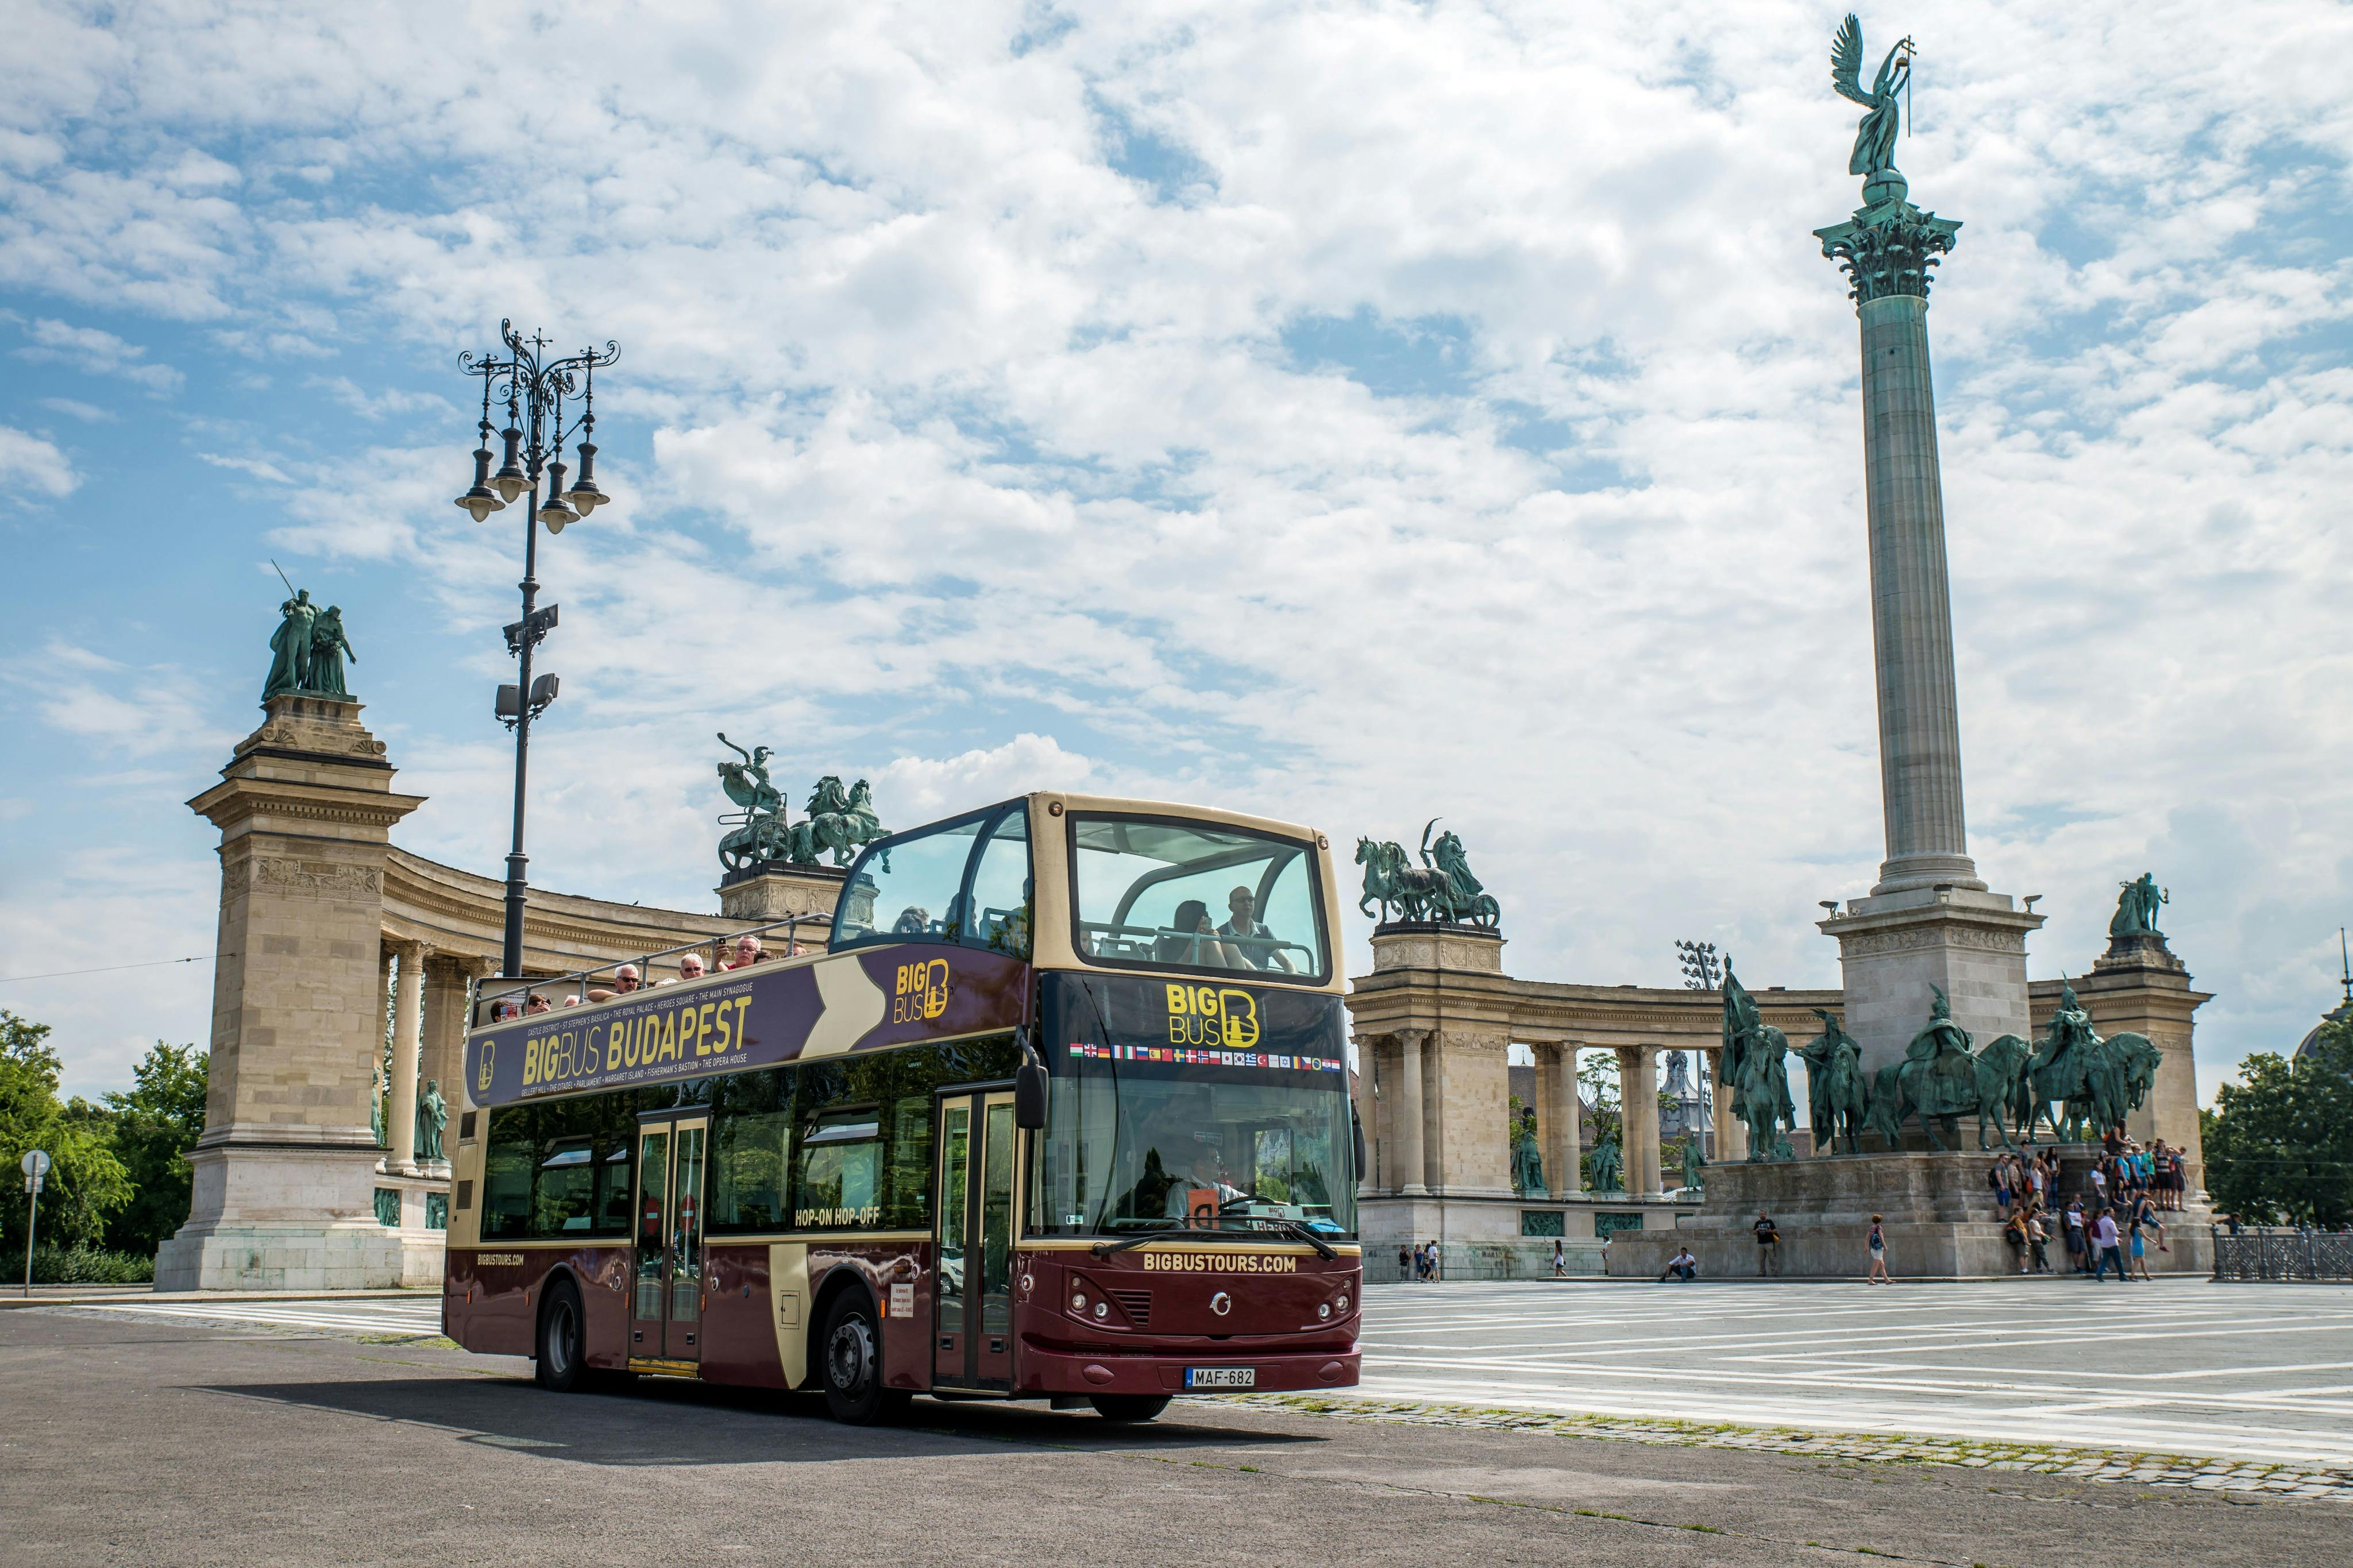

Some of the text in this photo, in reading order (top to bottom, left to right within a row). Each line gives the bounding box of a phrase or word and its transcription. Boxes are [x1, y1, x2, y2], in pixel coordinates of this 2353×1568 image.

[896, 962, 925, 995] BIG
[528, 982, 753, 1036] CASTLE DISTRICT ST STEPHEN'S BASILICA THE ROYAL PALACE HEROES SQUARE THE MAIN SYNAGOGUE
[894, 994, 923, 1024] BUS
[1166, 984, 1218, 1016] BIG
[607, 995, 752, 1071] BUDAPEST
[1169, 1016, 1220, 1046] BUS
[521, 1087, 538, 1097] GELLERT
[538, 1085, 546, 1094] HILL
[557, 1081, 573, 1091] CITADEL
[576, 1076, 601, 1087] PARLIAMENT
[605, 1072, 627, 1083] MARGARET
[628, 1069, 644, 1079] ISLAND
[647, 1064, 678, 1076] FISHERMAN'S
[678, 1061, 699, 1072] BASTION
[703, 1059, 711, 1068] THE
[713, 1057, 729, 1067] OPERA
[730, 1053, 747, 1064] HOUSE
[795, 1206, 880, 1226] HOP-ON HOP-OFF
[478, 1254, 524, 1265] BIGBUSTOURS.COM
[1144, 1253, 1296, 1272] BIGBUSTOURS.COM
[1195, 1370, 1252, 1384] MAF-682
